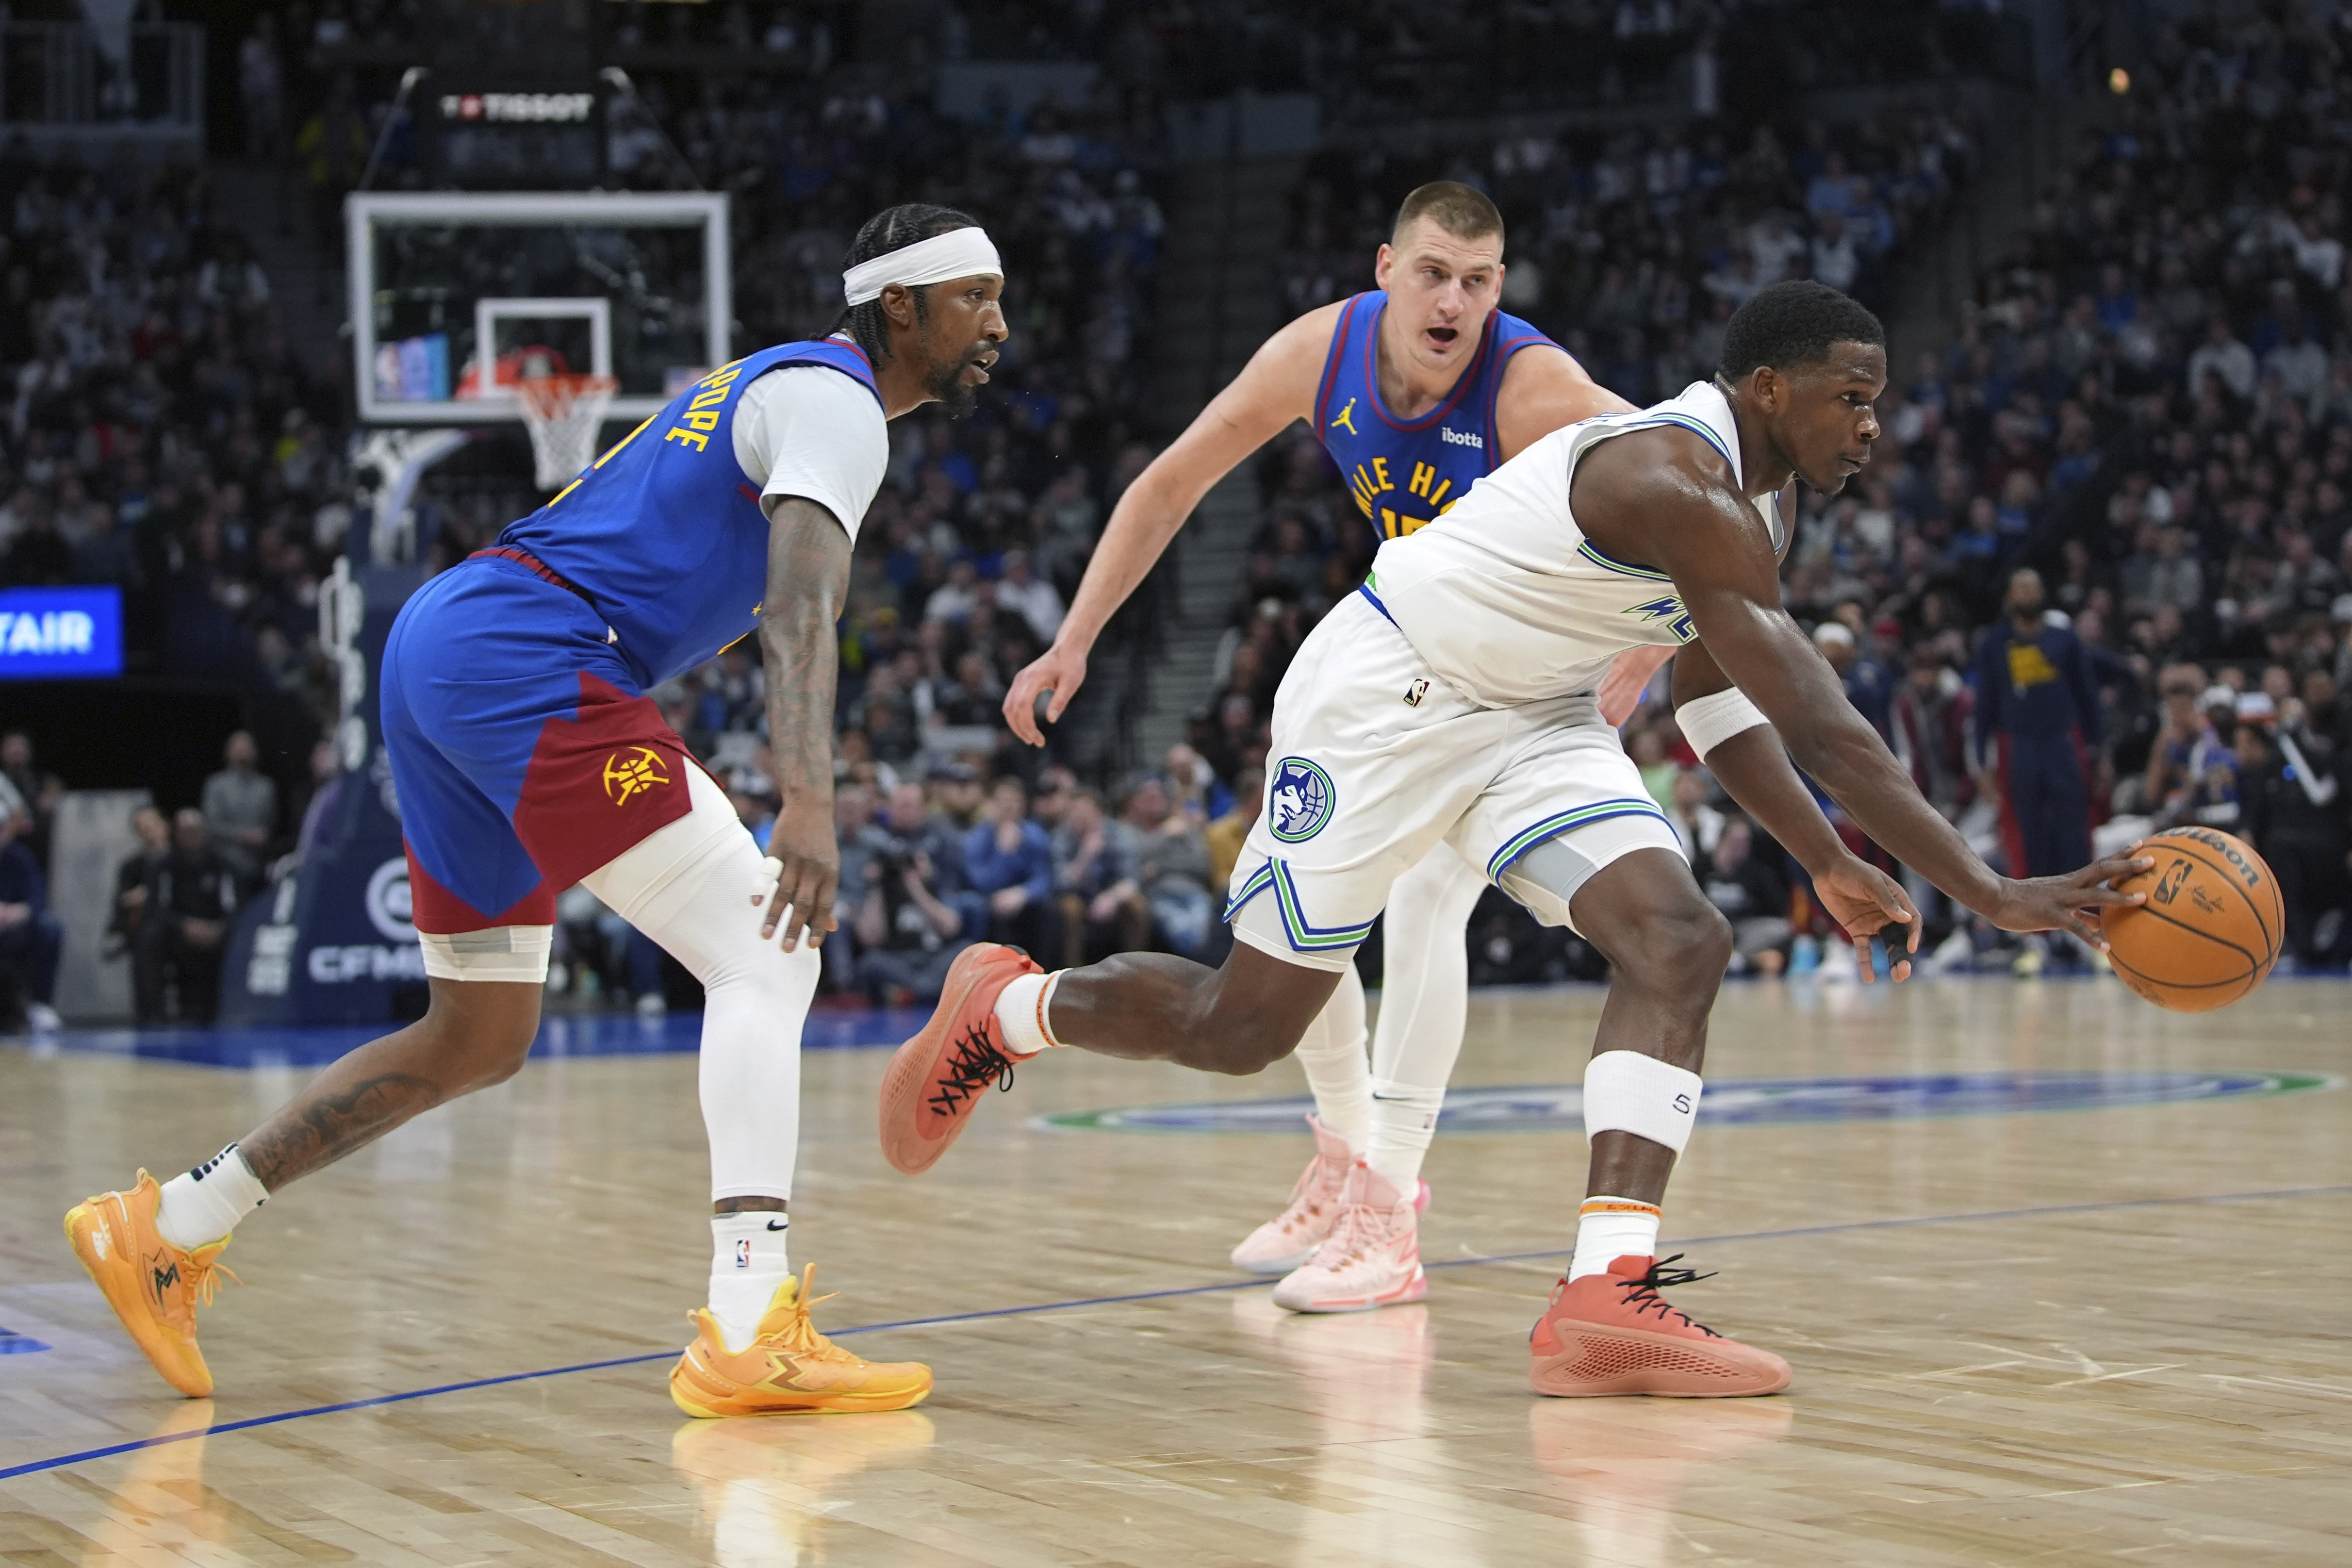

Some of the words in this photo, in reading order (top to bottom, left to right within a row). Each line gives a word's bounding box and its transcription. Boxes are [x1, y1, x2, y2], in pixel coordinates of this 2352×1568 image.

[484, 93, 594, 122] TISSOT
[664, 367, 743, 452] POPE
[1442, 427, 1483, 449] ibotta
[1409, 461, 1457, 515] HI
[1673, 1093, 1691, 1115] 5
